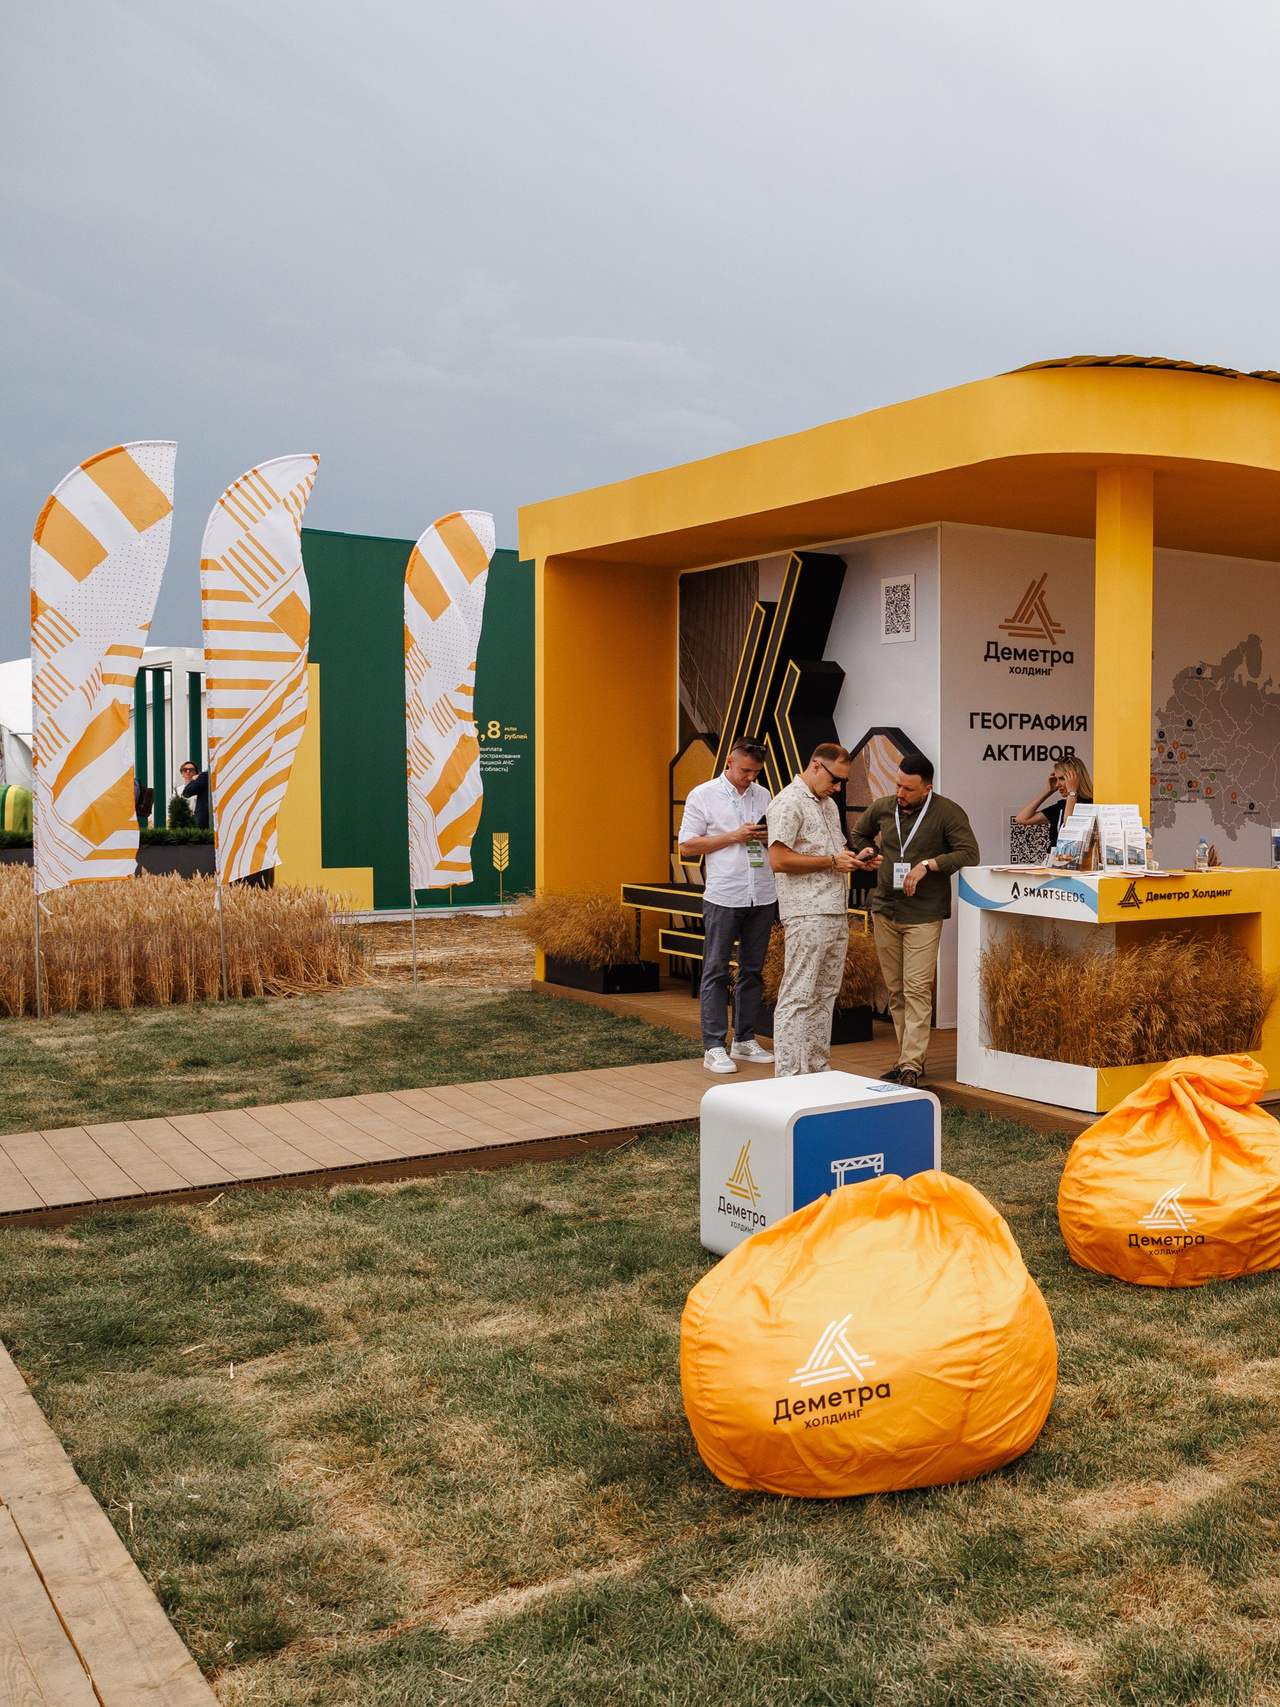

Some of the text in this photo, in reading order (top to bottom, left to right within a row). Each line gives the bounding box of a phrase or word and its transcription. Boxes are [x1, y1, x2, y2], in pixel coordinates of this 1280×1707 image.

[984, 641, 1074, 667] Деметра
[1008, 666, 1053, 676] холдинг
[969, 712, 1087, 731] ГЕОГРАФИЯ
[982, 744, 1075, 761] АКТИВОВ
[1023, 887, 1085, 903] SMARTSEEDS
[1146, 887, 1233, 902] Деметра Холдинг
[718, 1195, 766, 1227] Деметра
[730, 1220, 754, 1234] холдинг
[1128, 1233, 1205, 1248] Деметра
[773, 1383, 891, 1425] Деметра
[804, 1408, 863, 1429] холдинг
